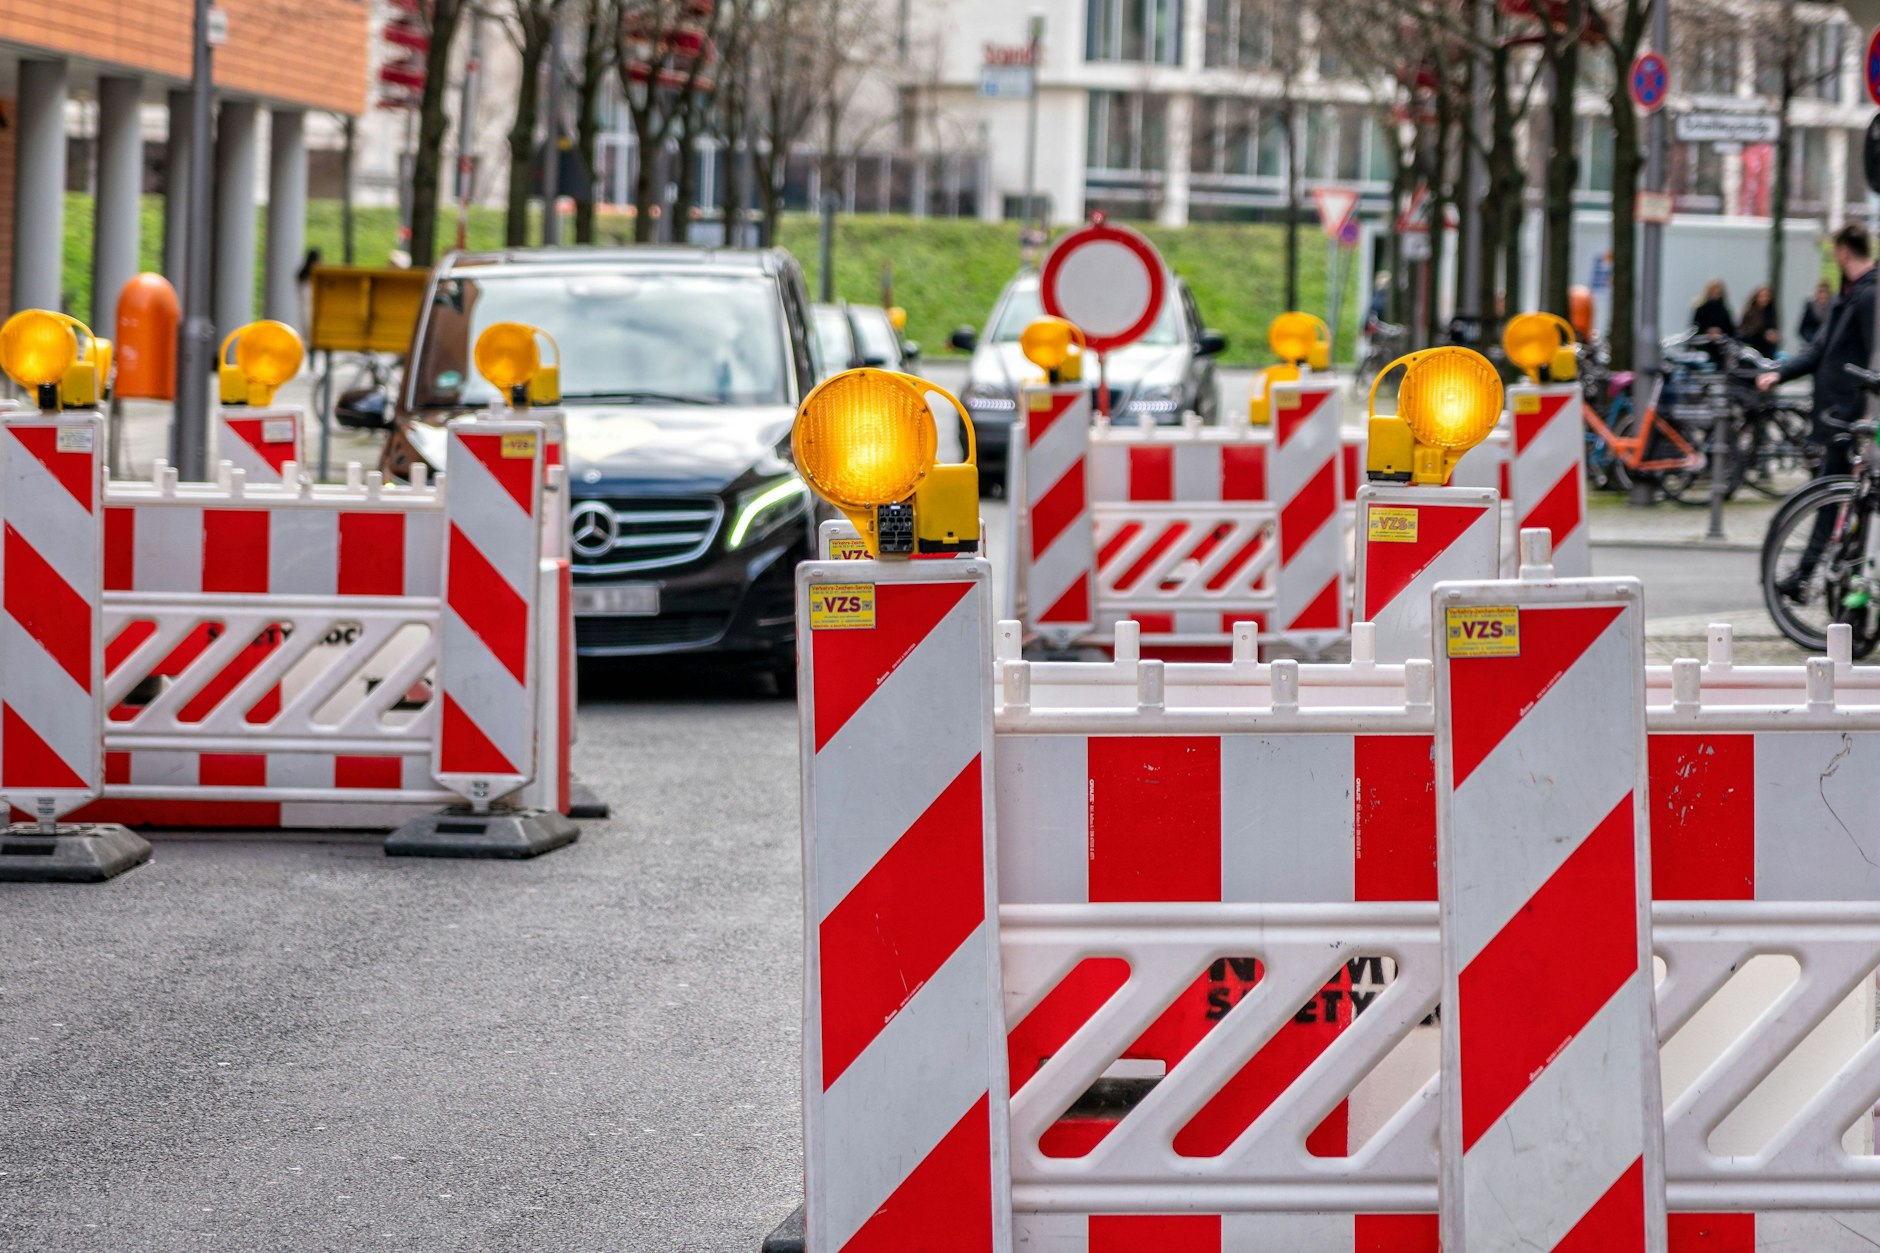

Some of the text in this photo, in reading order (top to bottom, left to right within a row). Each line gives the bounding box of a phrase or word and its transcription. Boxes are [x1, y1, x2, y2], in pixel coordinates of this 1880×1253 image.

[1379, 516, 1408, 530] VZS
[823, 597, 861, 613] VZS
[1462, 620, 1504, 639] VZS
